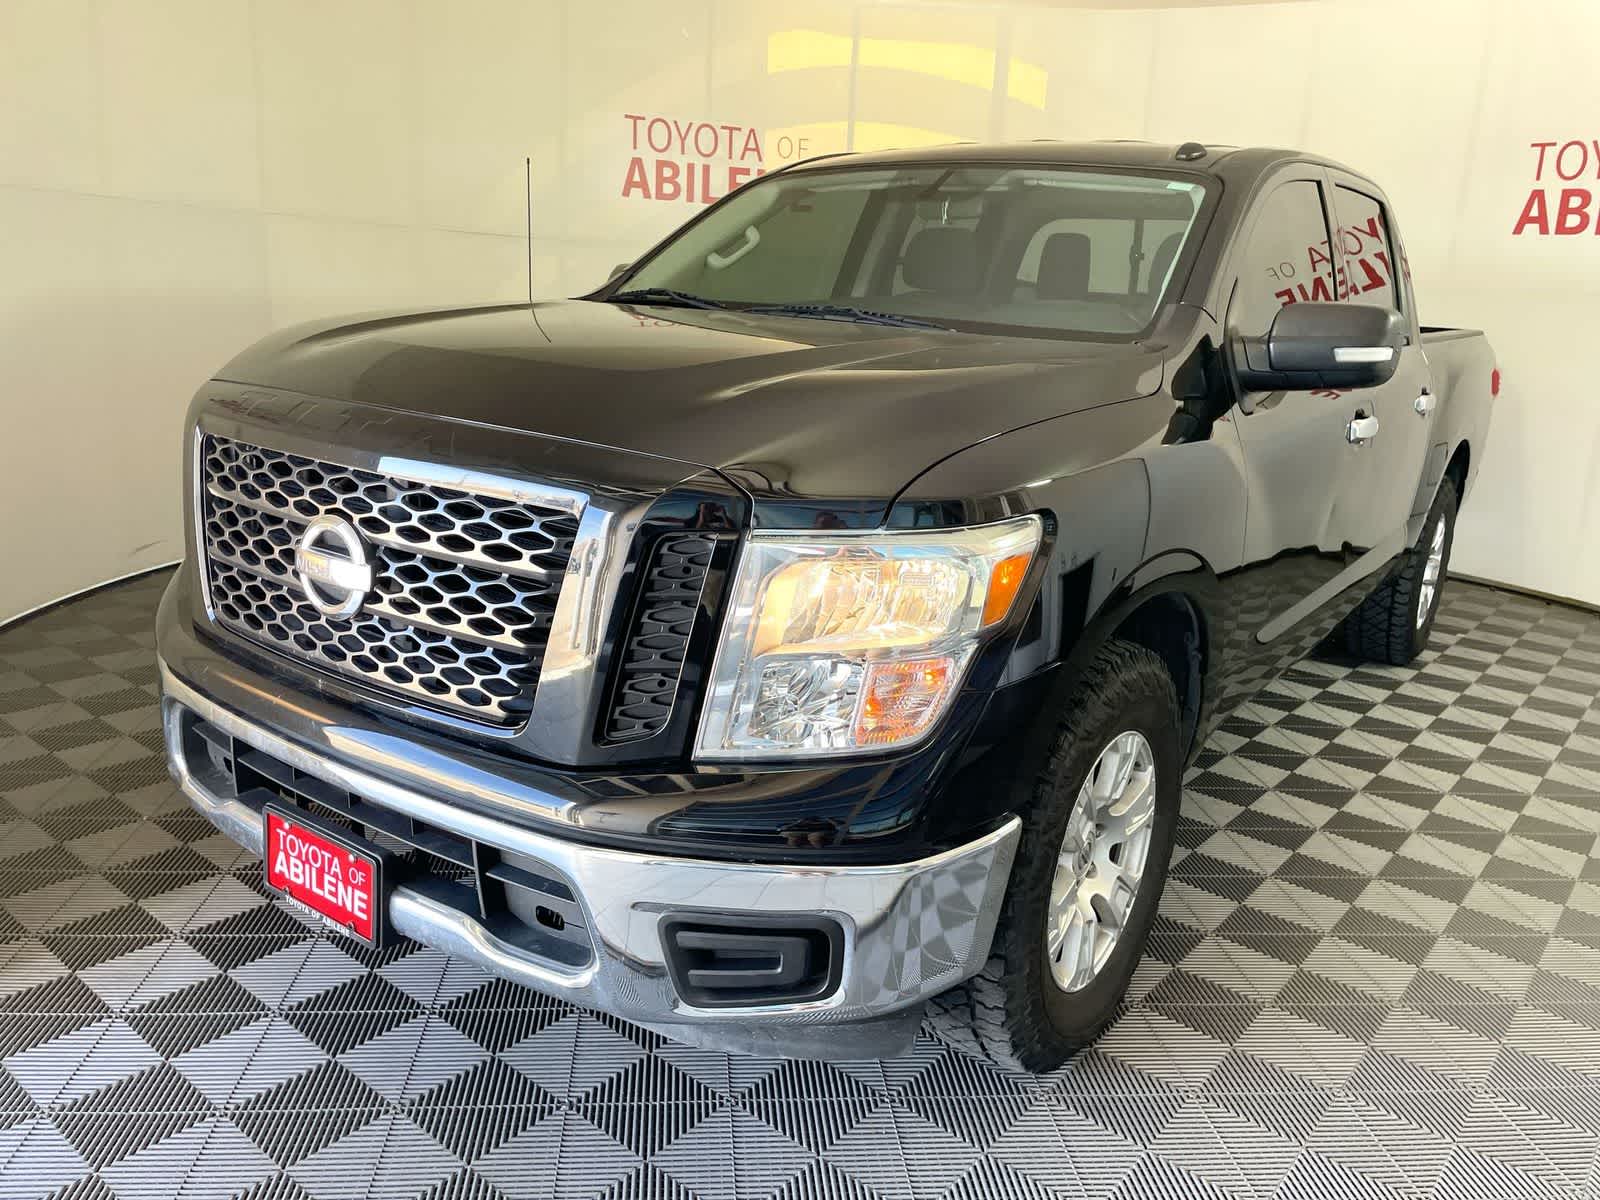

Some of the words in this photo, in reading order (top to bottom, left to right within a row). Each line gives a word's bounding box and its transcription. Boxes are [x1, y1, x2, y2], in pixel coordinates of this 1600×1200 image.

[624, 113, 763, 162] TOYOTA
[777, 135, 809, 160] OF
[275, 828, 343, 881] TOYOTA
[349, 867, 367, 887] OF
[274, 850, 369, 921] ABILENE
[285, 894, 310, 914] TOYOTA
[311, 909, 321, 921] OF
